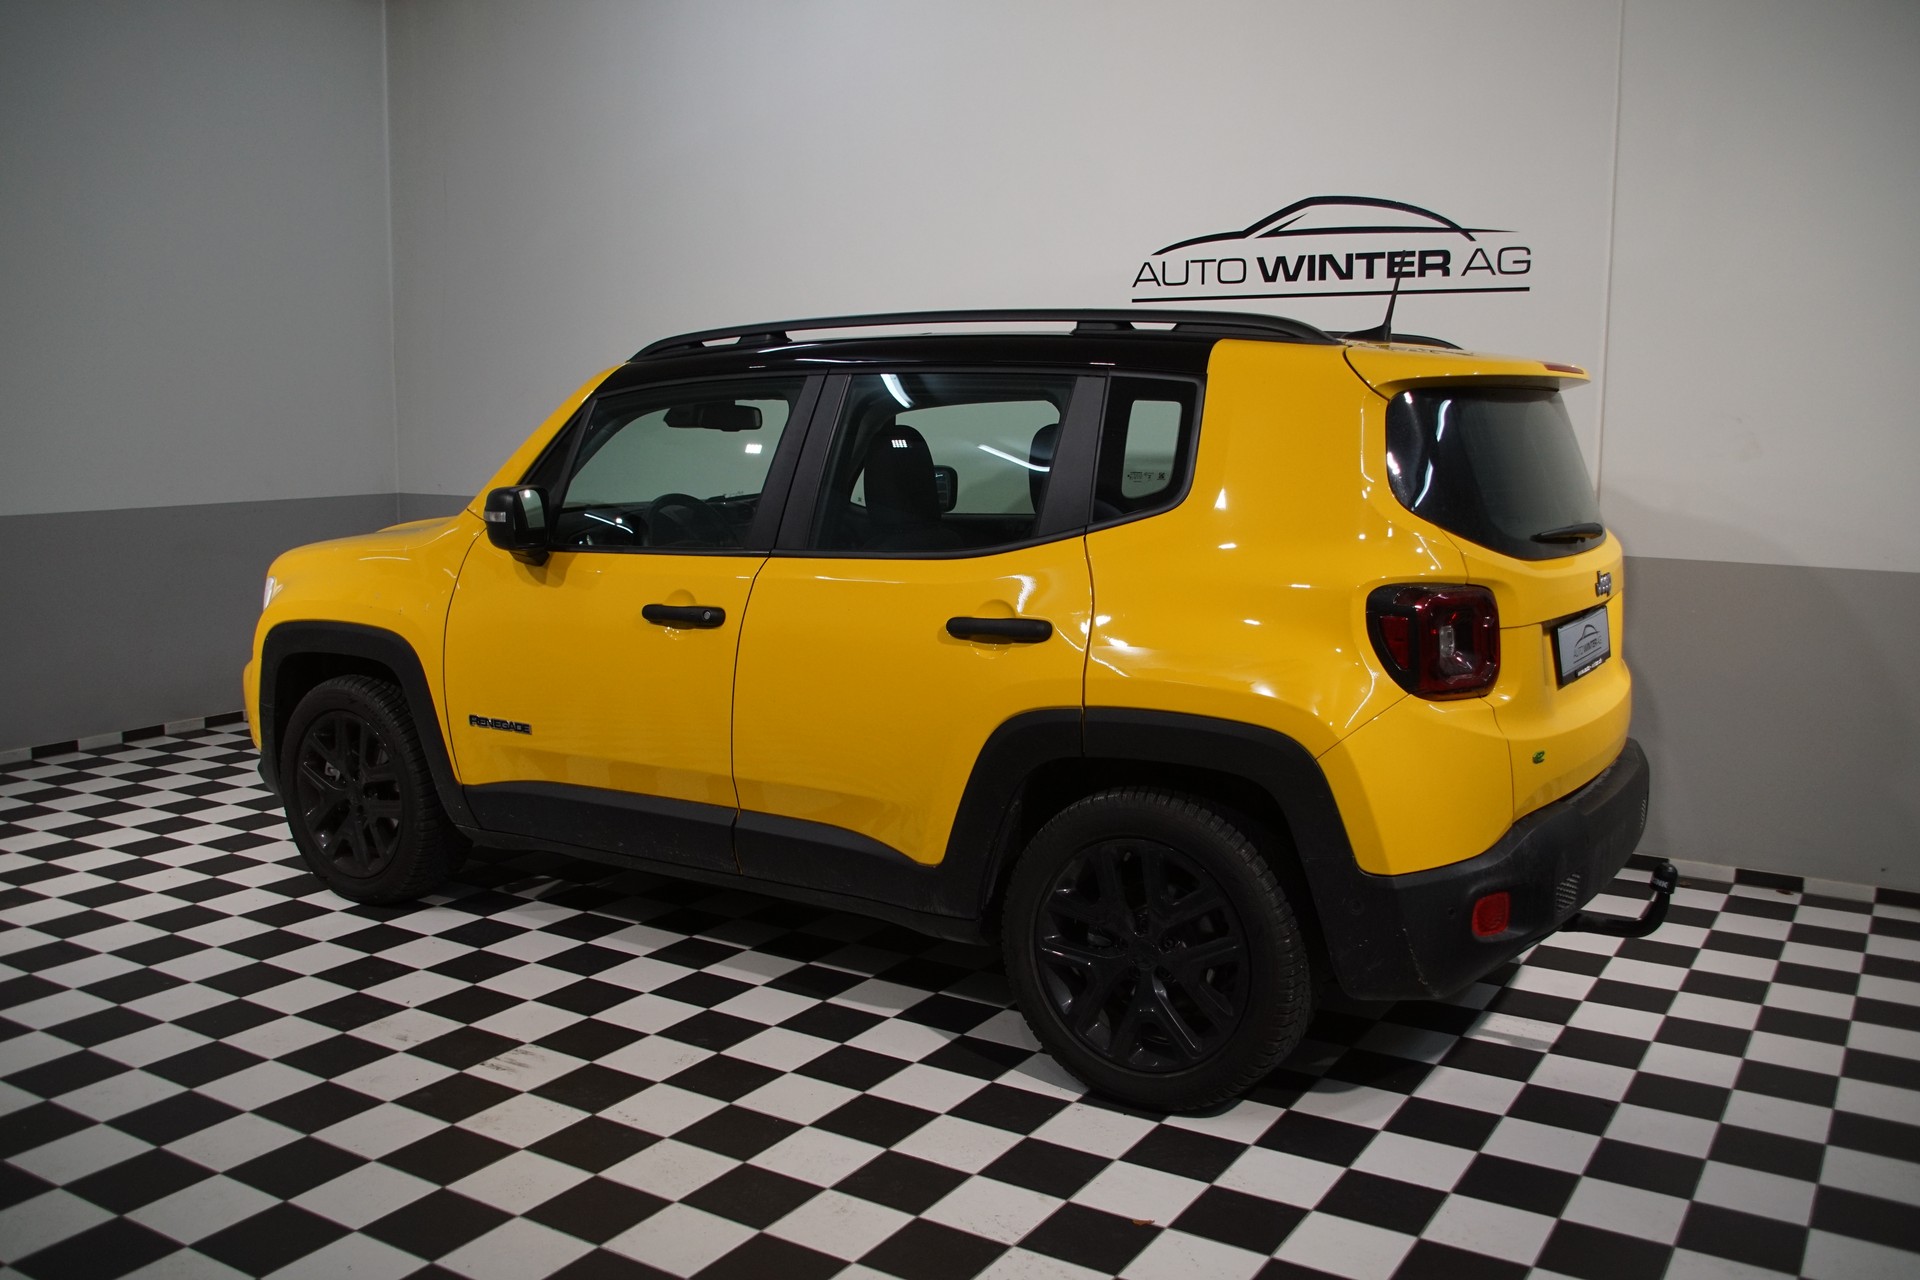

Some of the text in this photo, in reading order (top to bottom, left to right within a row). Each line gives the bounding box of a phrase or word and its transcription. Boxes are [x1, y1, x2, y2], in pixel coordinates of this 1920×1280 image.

[1132, 246, 1531, 288] AUTO WINTER AG
[469, 714, 532, 735] RENEGADE
